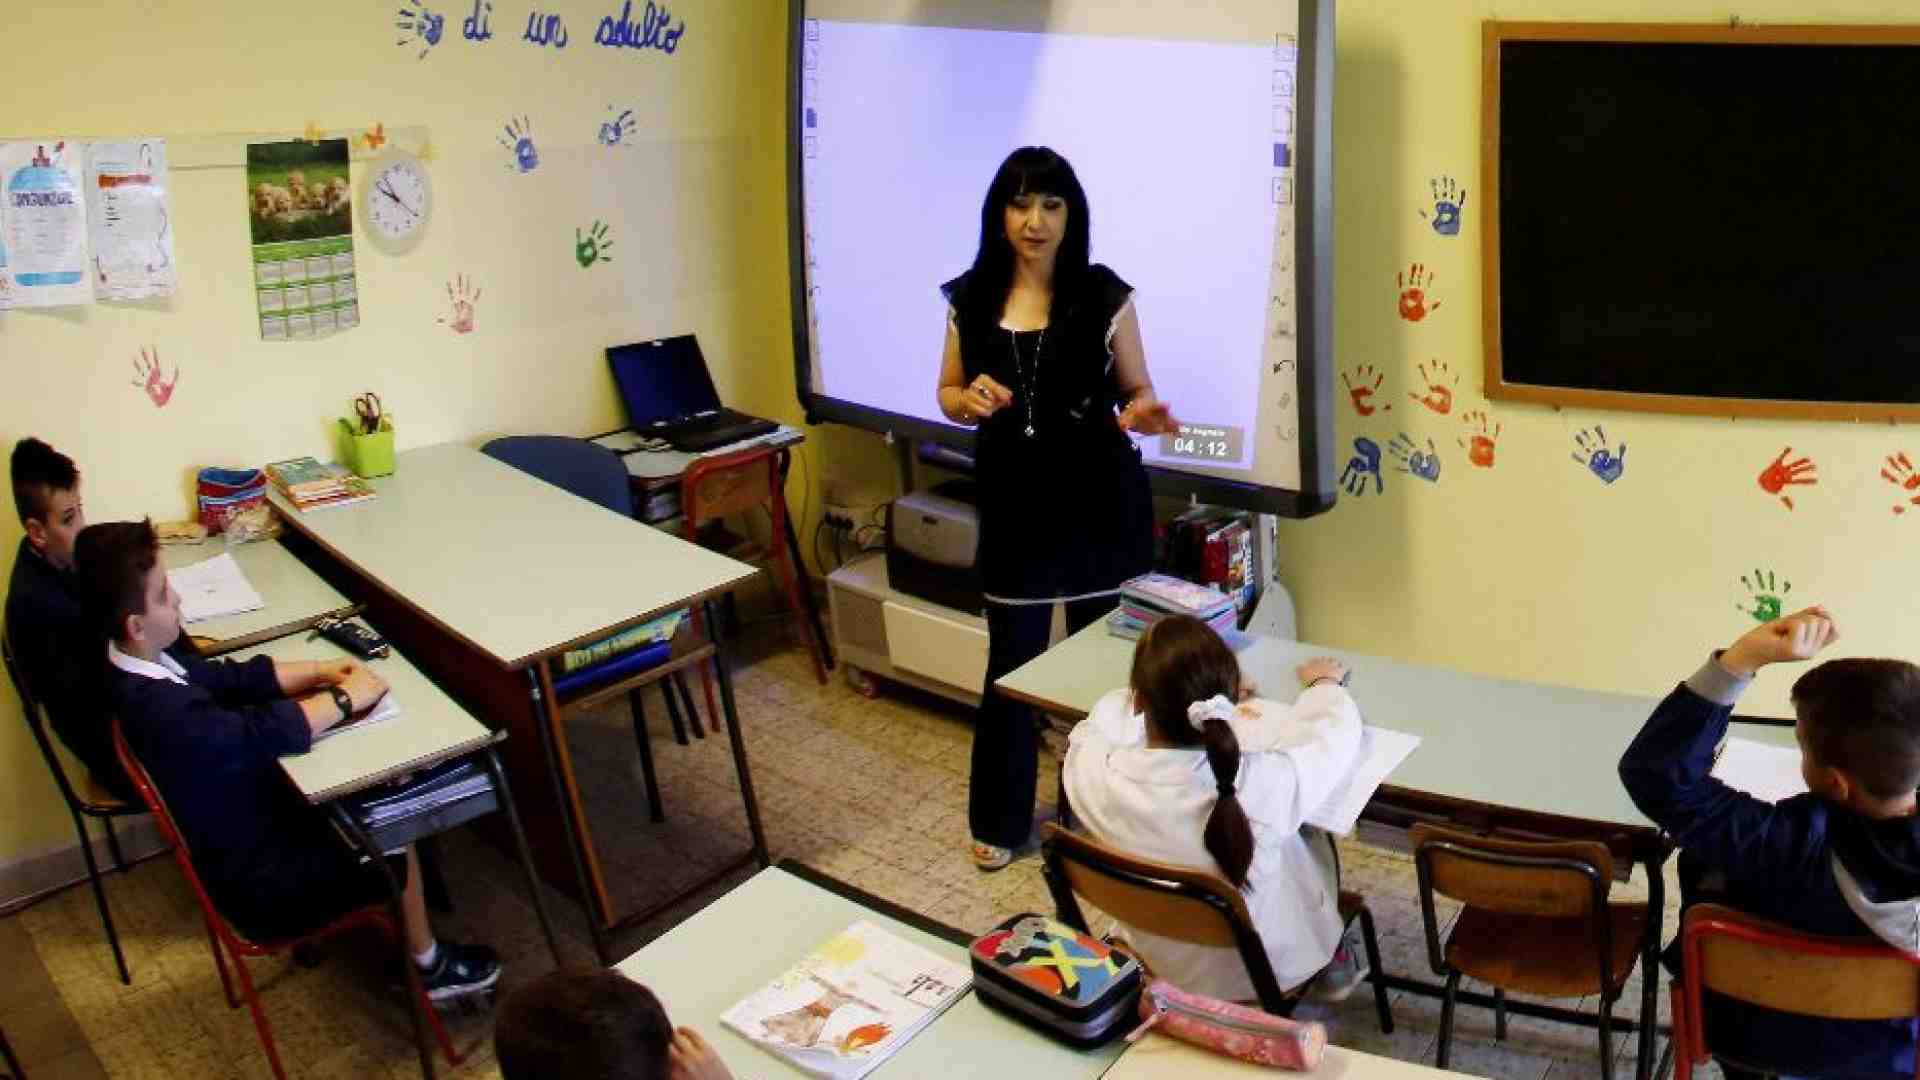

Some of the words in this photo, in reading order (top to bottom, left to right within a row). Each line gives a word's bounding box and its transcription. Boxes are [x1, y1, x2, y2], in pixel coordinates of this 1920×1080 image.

[462, 0, 493, 41] di
[523, 11, 568, 48] un
[594, 0, 686, 54] adulto
